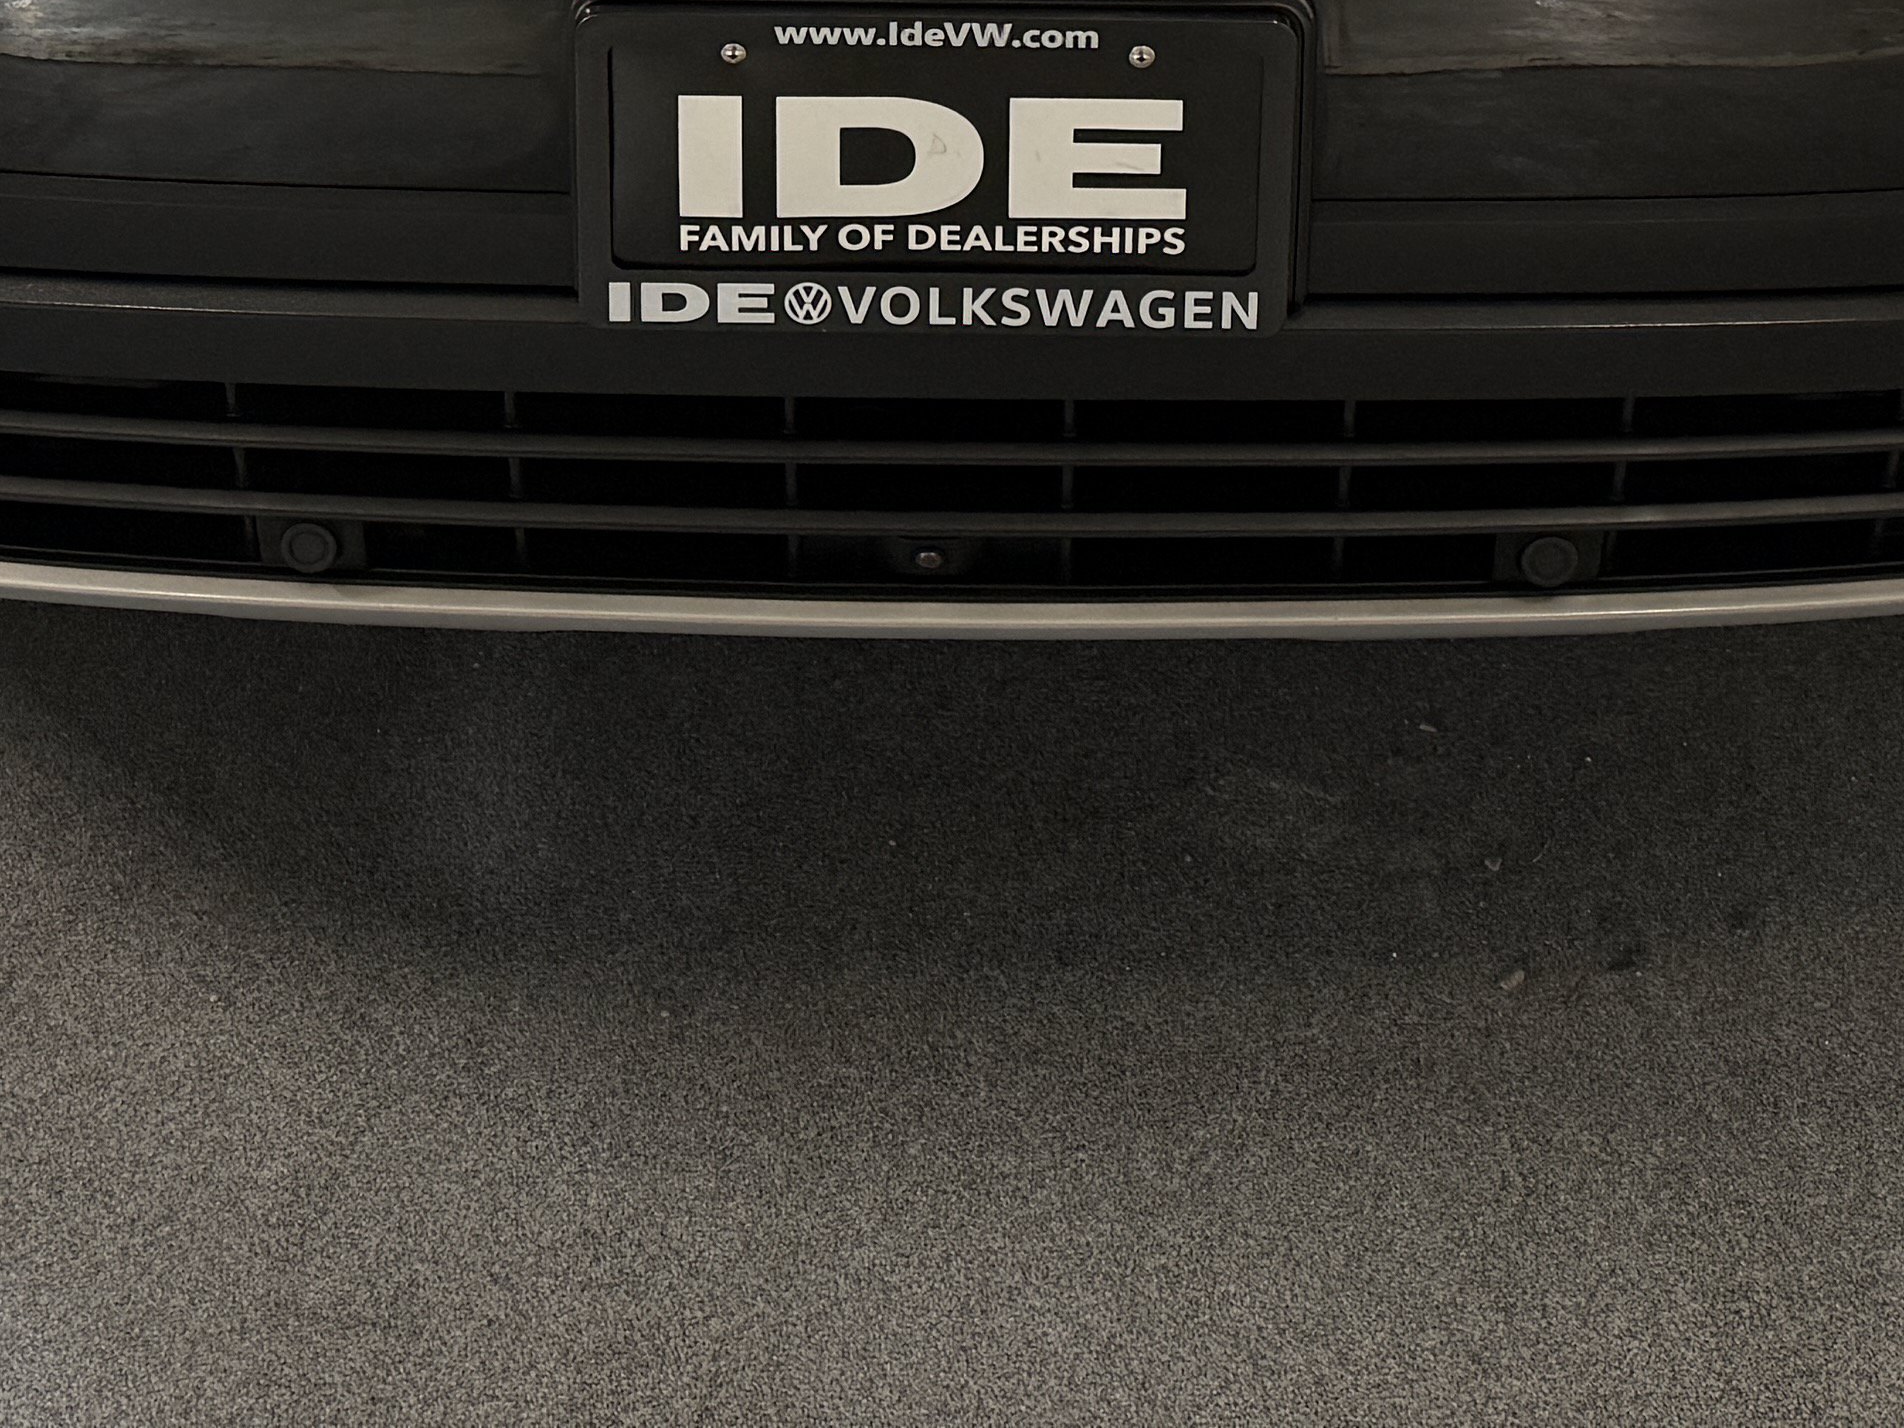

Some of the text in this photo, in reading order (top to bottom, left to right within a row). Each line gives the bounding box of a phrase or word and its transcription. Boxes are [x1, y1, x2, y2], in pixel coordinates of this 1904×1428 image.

[774, 20, 1100, 50] www.IdeVW.com
[677, 94, 1187, 220] IDE
[679, 223, 1186, 255] FAMILY OF DEALERSHIPS
[608, 281, 775, 324] IDE
[837, 285, 1259, 330] VOLKSWAGEN
